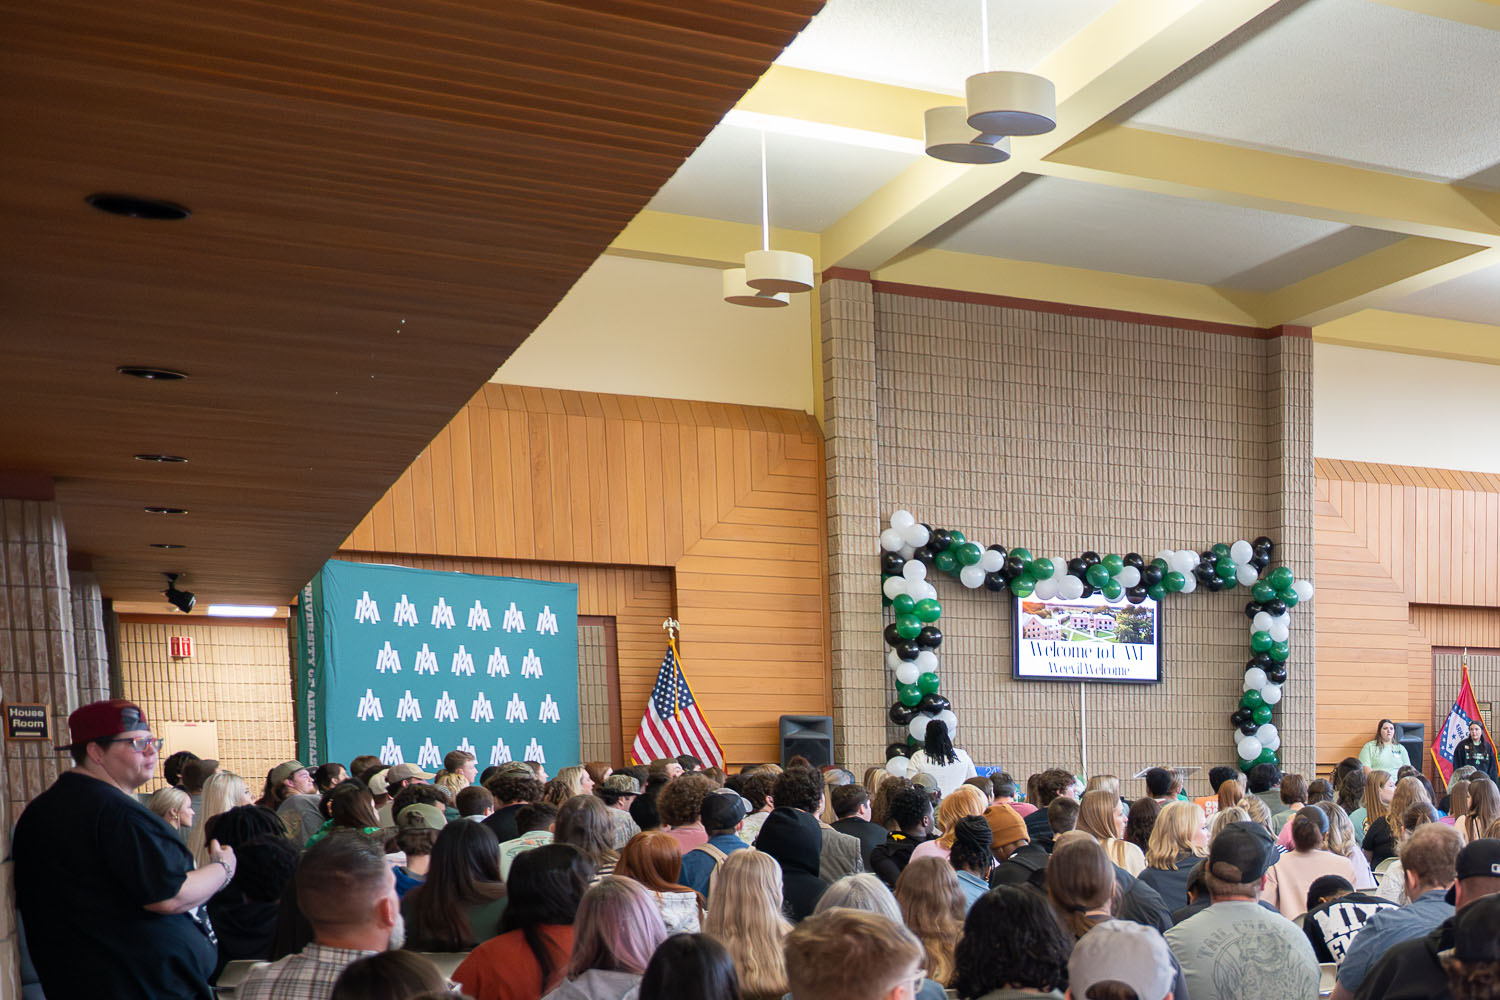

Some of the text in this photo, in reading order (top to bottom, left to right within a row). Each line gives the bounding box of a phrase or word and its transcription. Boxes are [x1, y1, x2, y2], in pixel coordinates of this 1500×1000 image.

[1030, 641, 1092, 658] Welcome
[1097, 647, 1109, 658] to
[9, 708, 44, 717] House
[13, 718, 44, 728] Room
